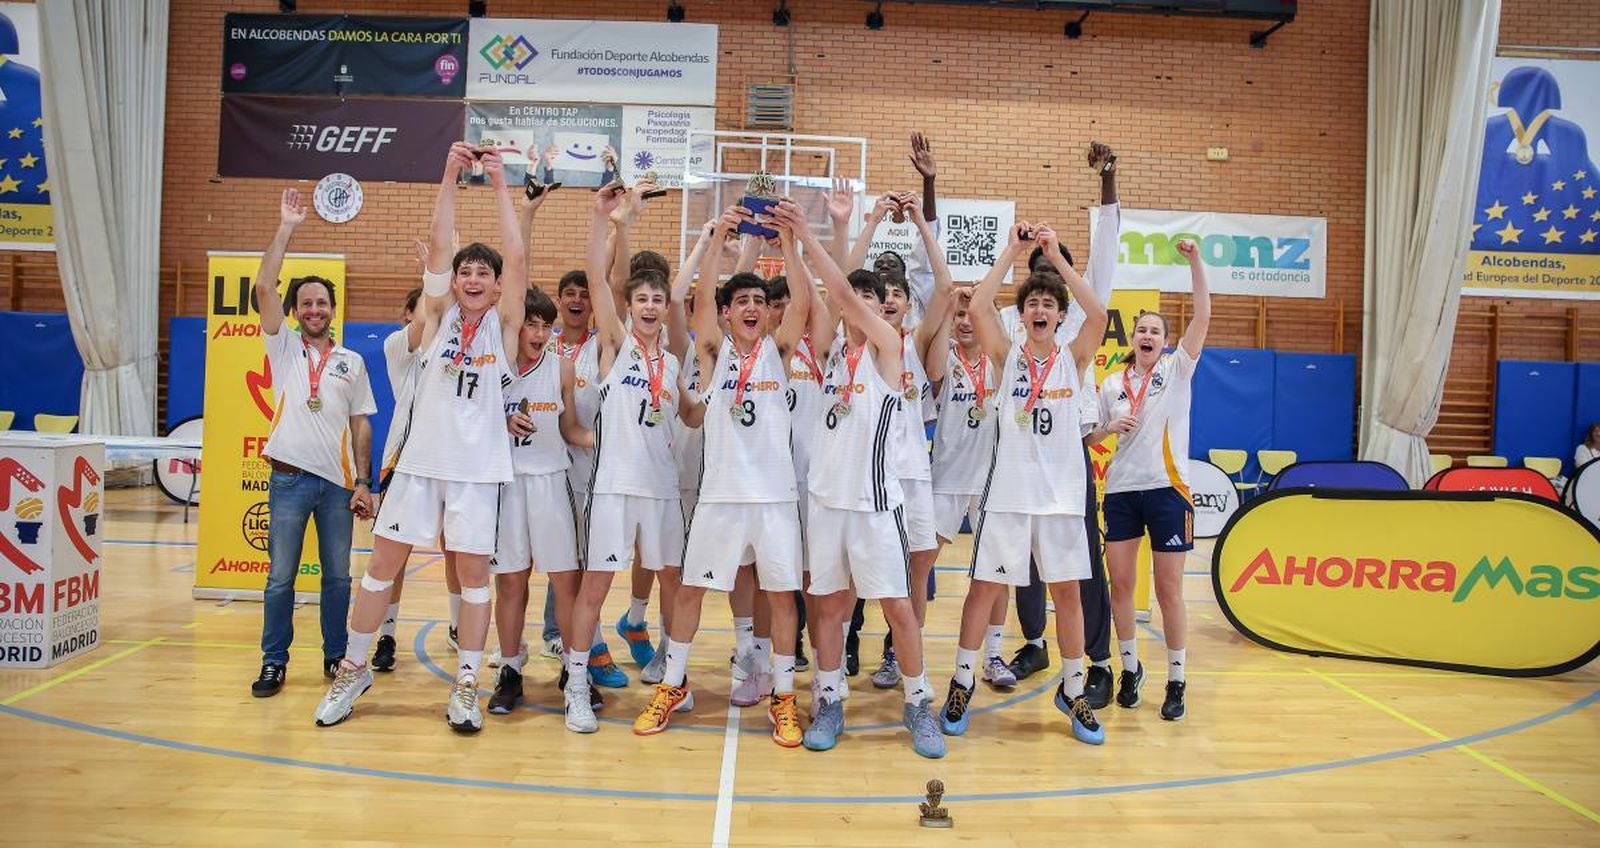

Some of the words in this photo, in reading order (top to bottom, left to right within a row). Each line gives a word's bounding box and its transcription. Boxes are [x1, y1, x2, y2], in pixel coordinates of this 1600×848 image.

[231, 28, 247, 39] EN
[249, 28, 326, 41] ALCOBENDAS
[328, 30, 373, 42] DAMOS
[375, 31, 389, 42] LA
[392, 32, 422, 43] CARA
[425, 32, 448, 44] POR
[451, 33, 461, 44] TI
[551, 49, 603, 61] Fundación
[605, 50, 648, 63] Deporte
[650, 52, 709, 63] Alcobendas
[577, 67, 683, 78] #TODOSCONJUGAMOS
[509, 106, 521, 115] En
[523, 106, 559, 116] CENTRO
[561, 107, 578, 116] TAP
[470, 116, 485, 125] nos
[488, 117, 513, 127] gusta
[515, 117, 544, 127] hablar
[546, 118, 558, 127] de
[560, 117, 618, 128] SOLUCIONES.
[315, 126, 398, 153] GEFF
[869, 242, 912, 250] PATROCIN
[1481, 256, 1566, 270] Alcobendas,
[1231, 271, 1245, 280] es
[1248, 270, 1311, 282] ortodoncia
[1476, 272, 1519, 285] Europea
[1522, 274, 1538, 283] del
[1542, 274, 1586, 286] Deporte
[456, 369, 480, 399] 17
[1031, 407, 1053, 436] 19
[1192, 493, 1228, 512] any
[54, 570, 99, 613] FBM
[52, 629, 97, 660] MADRID
